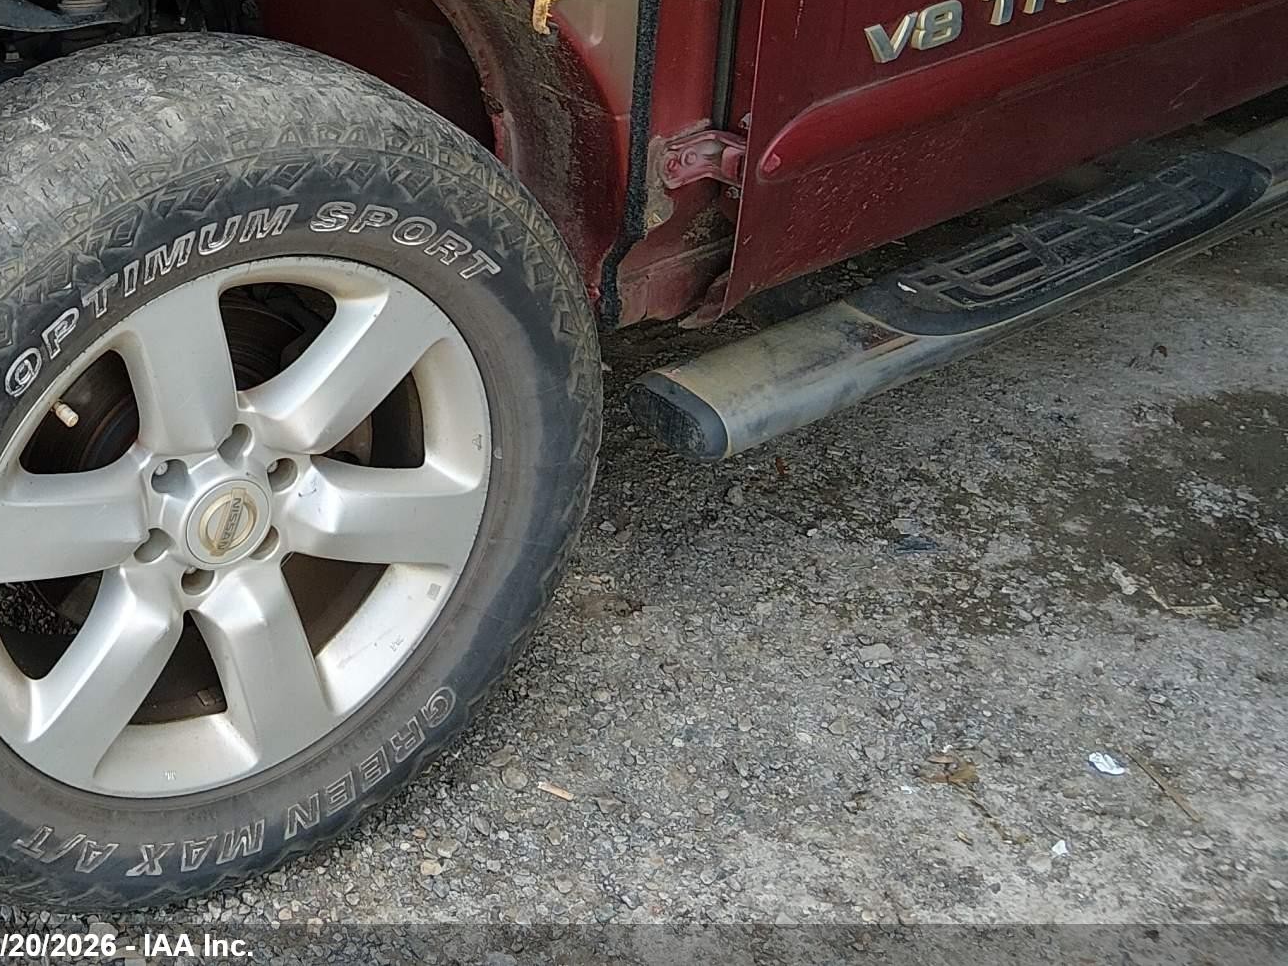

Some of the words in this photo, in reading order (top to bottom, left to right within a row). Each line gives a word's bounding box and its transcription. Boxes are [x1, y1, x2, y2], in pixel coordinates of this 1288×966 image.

[4, 203, 300, 399] OPTIMUM
[309, 200, 502, 282] SPORT
[216, 497, 243, 550] NISSAN
[284, 685, 458, 841] GREEN
[15, 824, 120, 875] A/T
[125, 818, 266, 878] MAX
